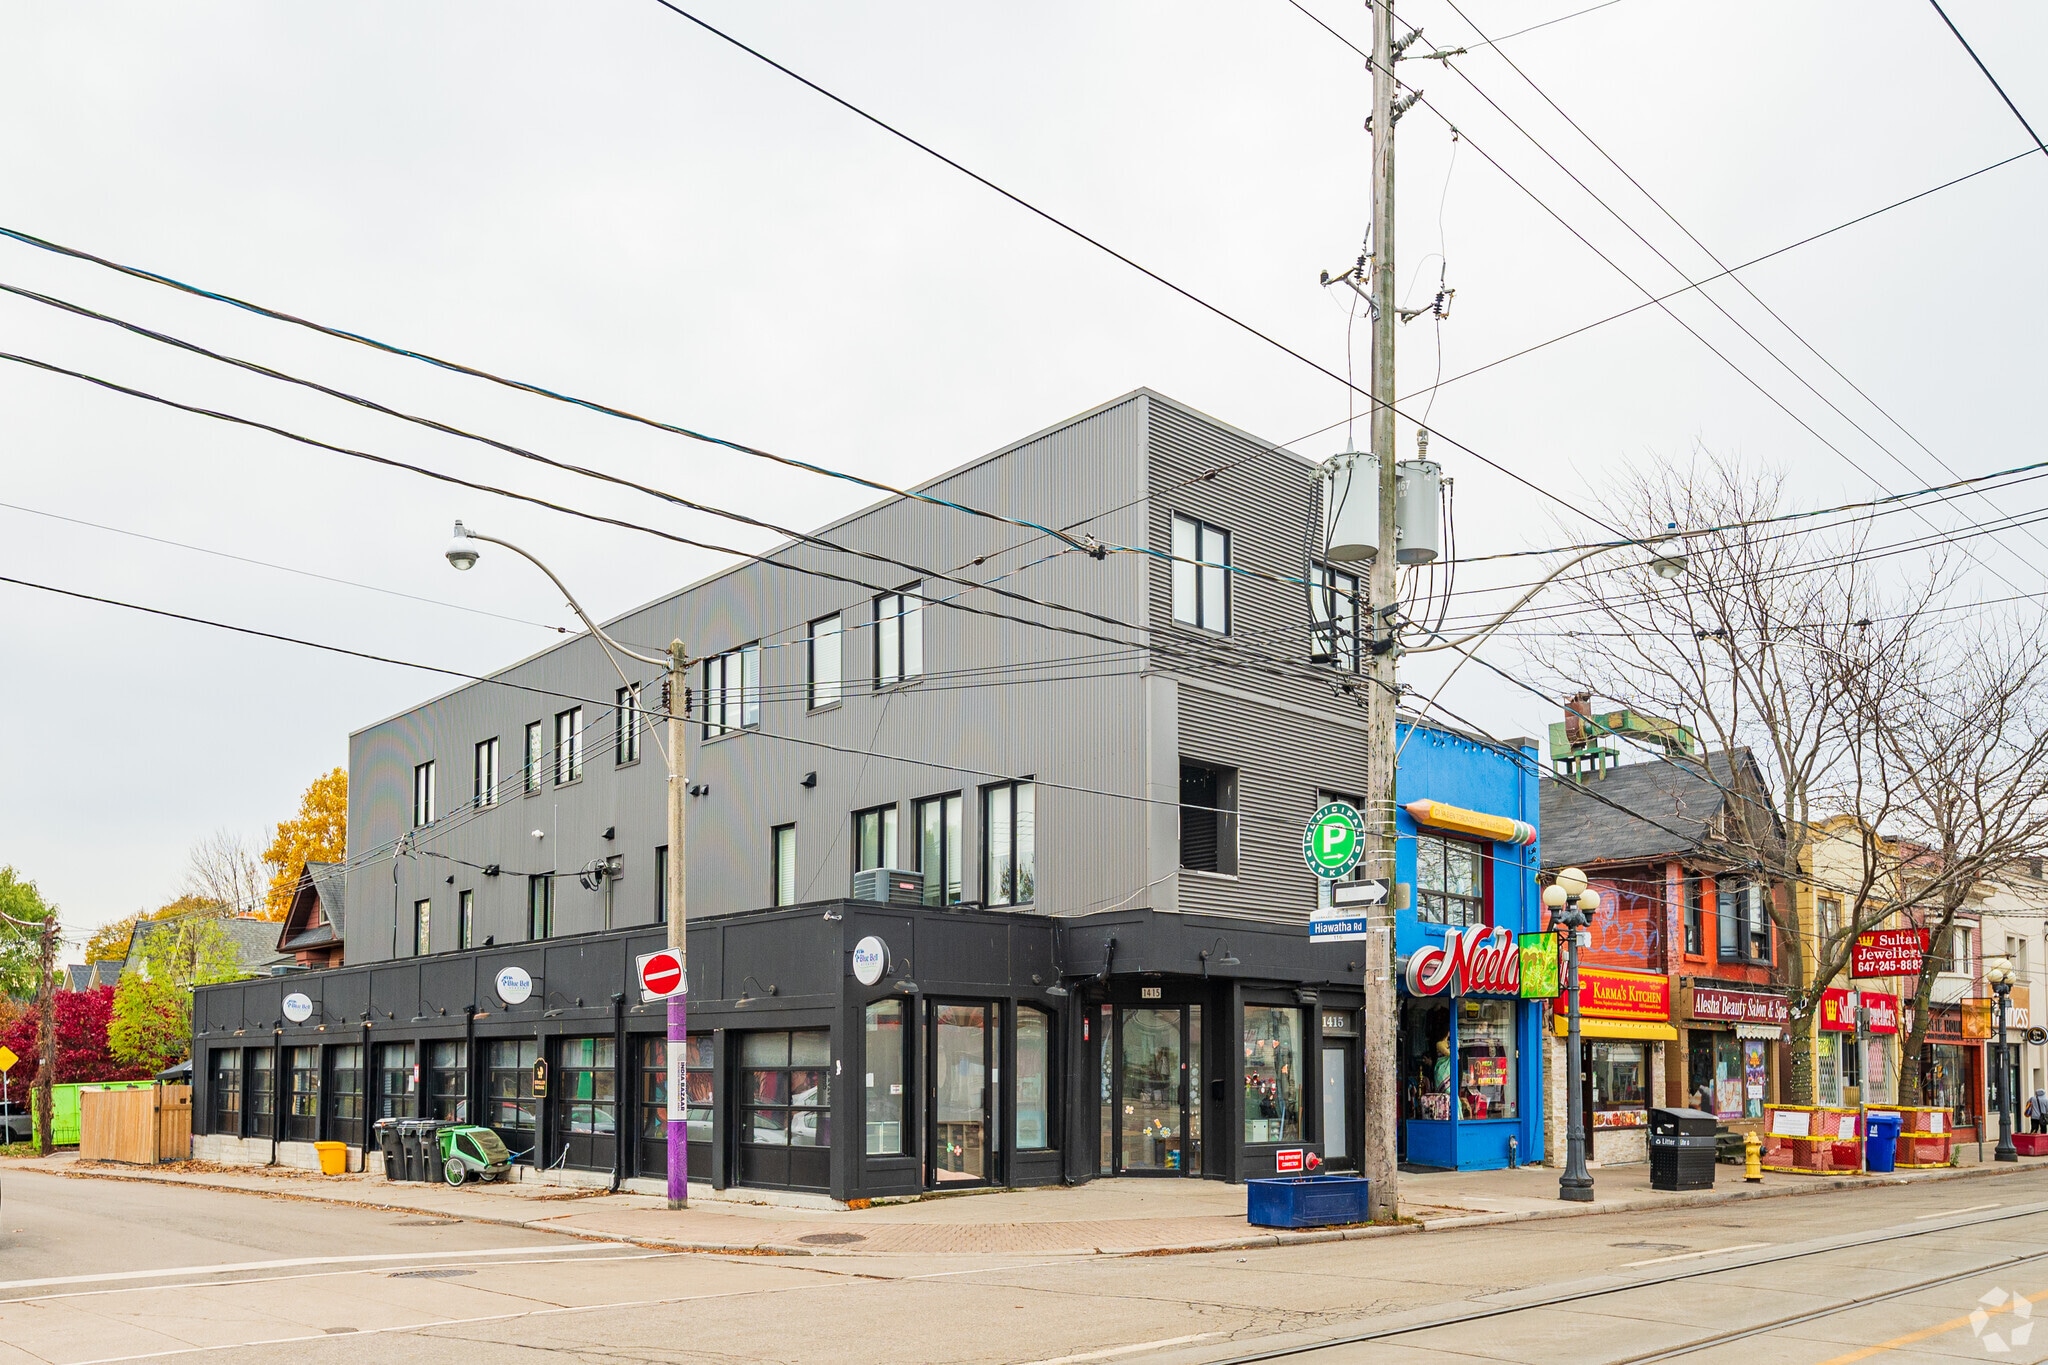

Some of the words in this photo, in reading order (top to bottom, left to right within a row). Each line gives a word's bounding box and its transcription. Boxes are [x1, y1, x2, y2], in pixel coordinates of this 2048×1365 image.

[1323, 822, 1346, 853] P
[1306, 844, 1361, 876] PARKING
[1314, 921, 1352, 934] Hiawatha
[1353, 922, 1362, 931] Rd
[1879, 934, 1921, 946] Sultan
[1858, 947, 1923, 960] Jewellers
[1143, 988, 1160, 997] 1415
[1721, 996, 1746, 1020] Beauty
[1747, 998, 1766, 1018] Salon
[1767, 1000, 1774, 1018] &
[1774, 1001, 1788, 1022] Spa
[1323, 1016, 1343, 1027] 1415
